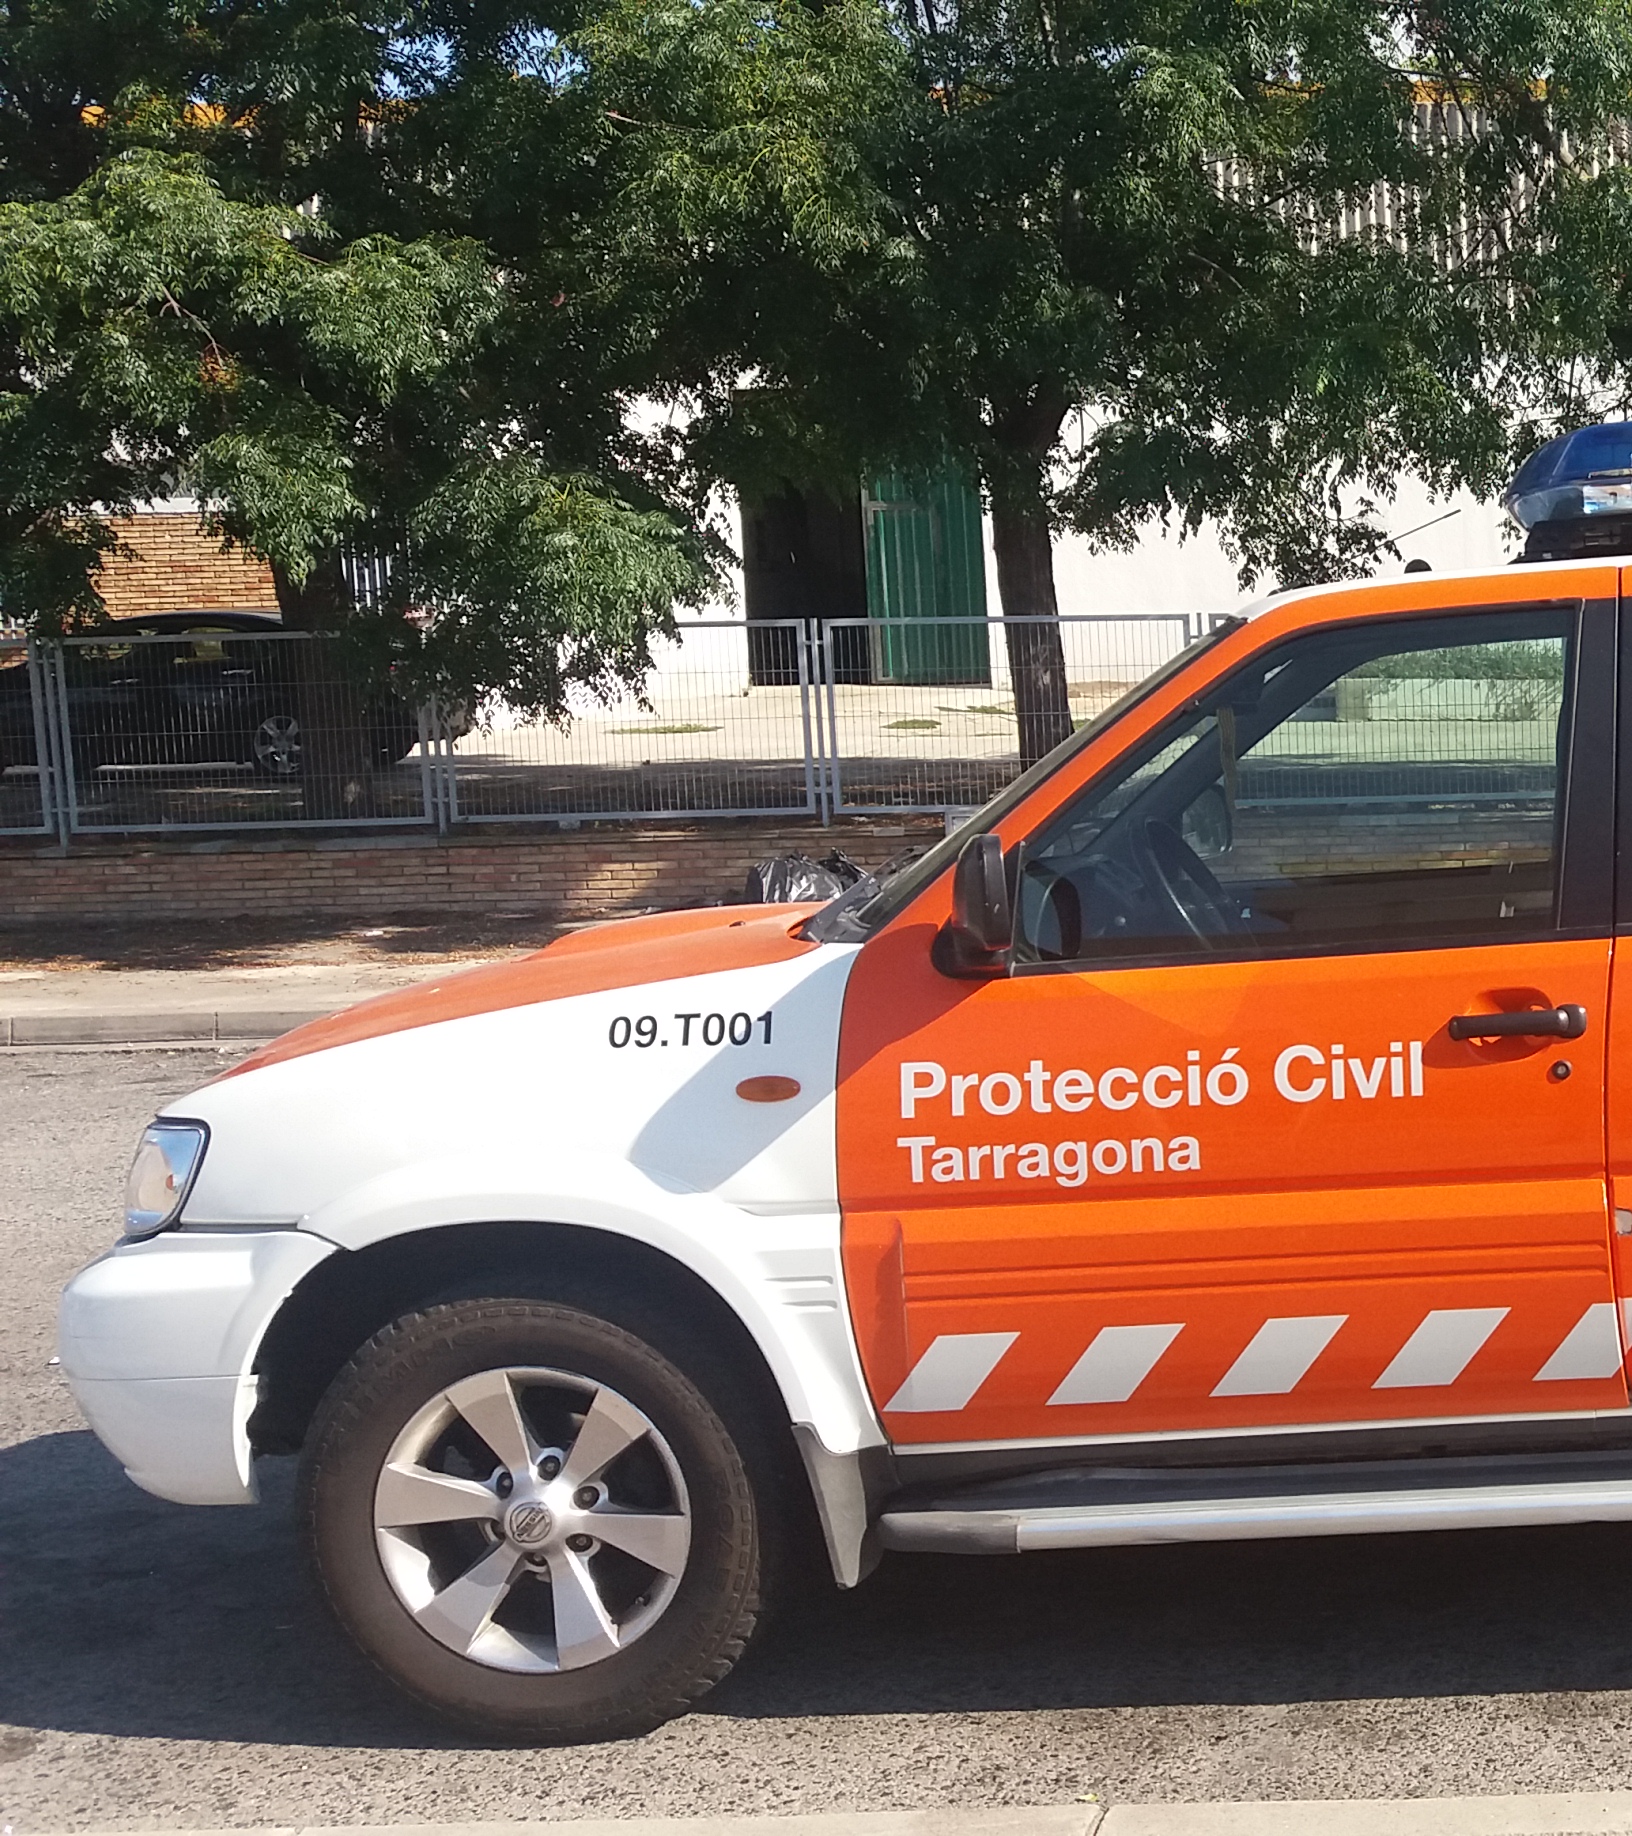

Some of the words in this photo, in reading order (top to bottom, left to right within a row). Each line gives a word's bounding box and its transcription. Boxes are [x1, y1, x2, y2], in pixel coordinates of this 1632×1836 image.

[608, 1010, 773, 1048] 09.T001
[899, 1046, 1249, 1119] Protecció
[1272, 1040, 1424, 1103] Civil
[896, 1136, 1201, 1188] Tarragona
